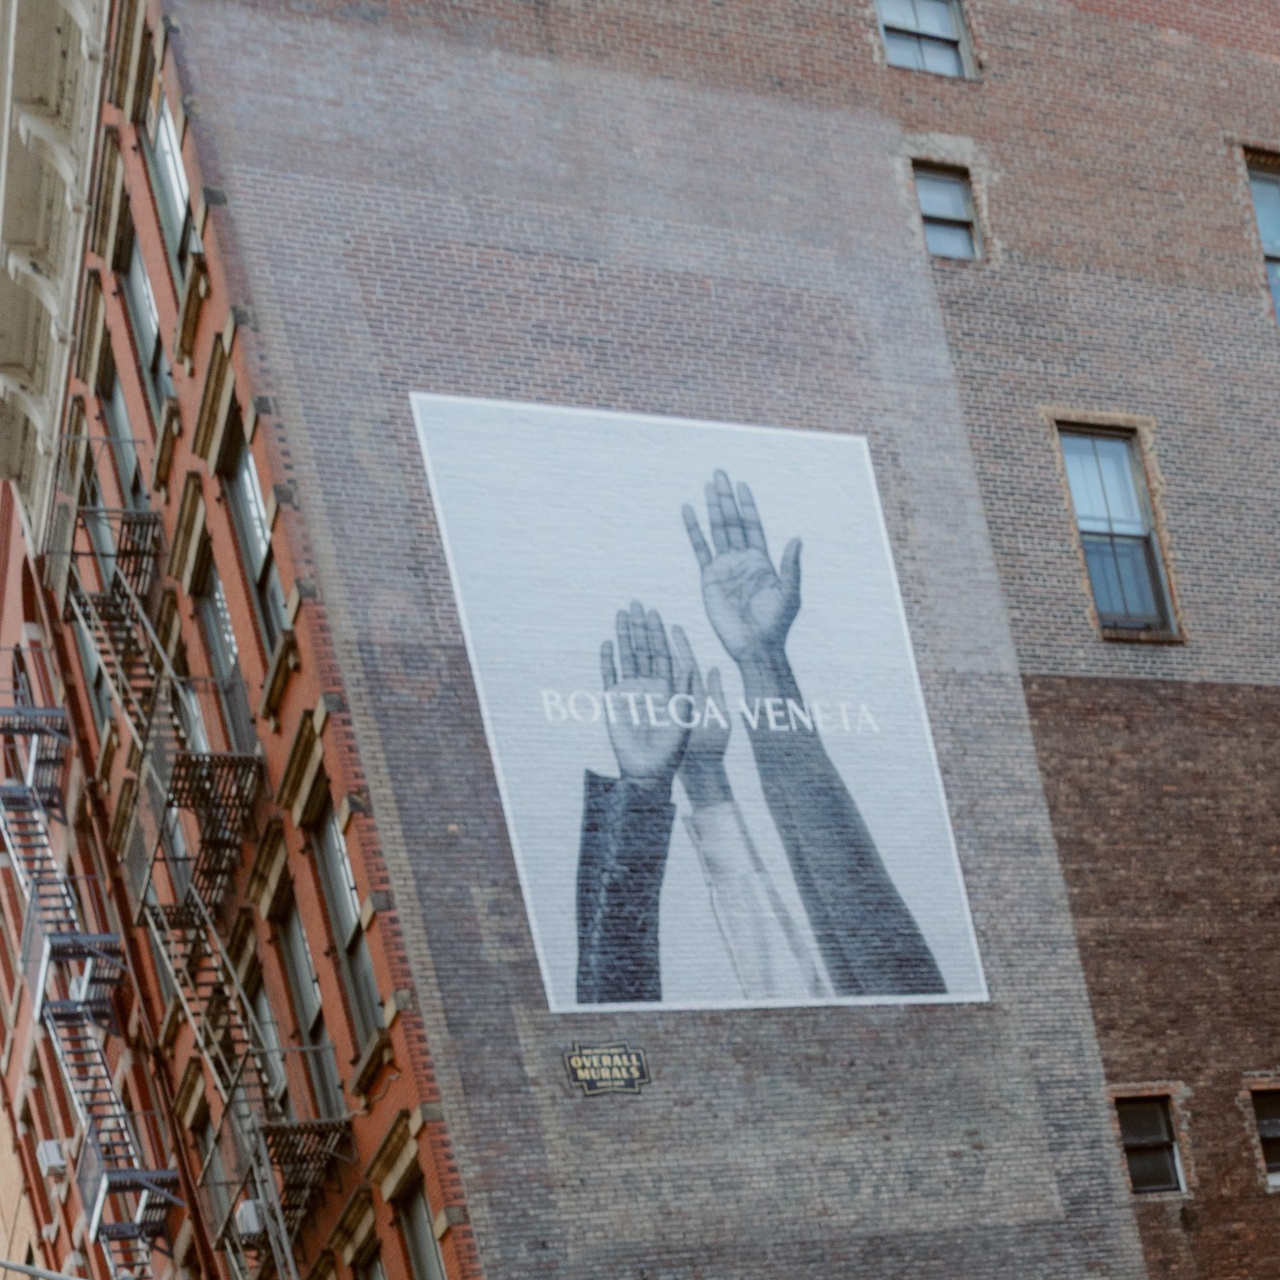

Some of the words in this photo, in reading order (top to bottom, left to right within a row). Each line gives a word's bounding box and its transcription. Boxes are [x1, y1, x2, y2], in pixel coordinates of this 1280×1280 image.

[541, 690, 729, 729] BOTTEGA
[737, 697, 881, 733] VENETA
[570, 1053, 640, 1069] OVERALL
[576, 1066, 640, 1080] MURALS
